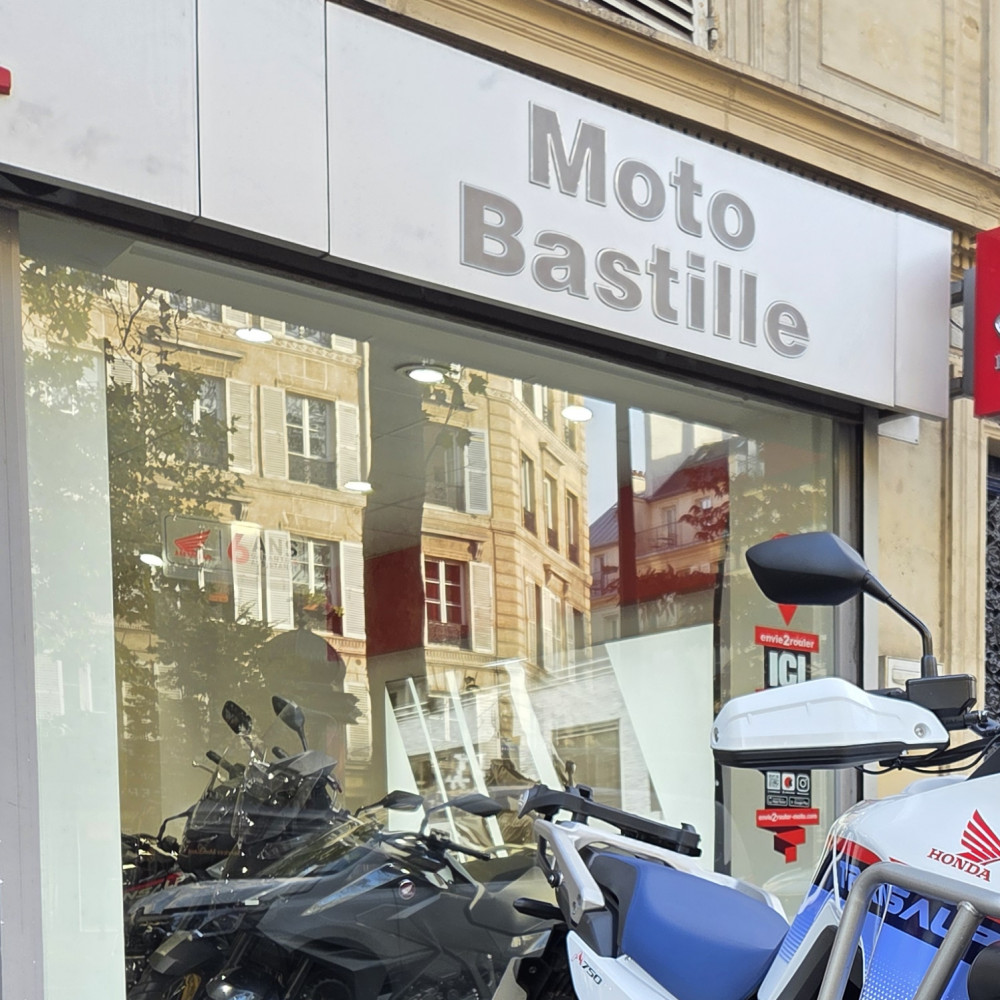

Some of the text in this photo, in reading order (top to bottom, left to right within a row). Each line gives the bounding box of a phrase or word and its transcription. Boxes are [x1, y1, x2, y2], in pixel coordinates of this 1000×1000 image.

[528, 100, 756, 251] Moto
[460, 180, 810, 358] Bastille
[768, 650, 806, 687] ICI
[927, 848, 991, 882] HONDA
[582, 960, 603, 985] 750
